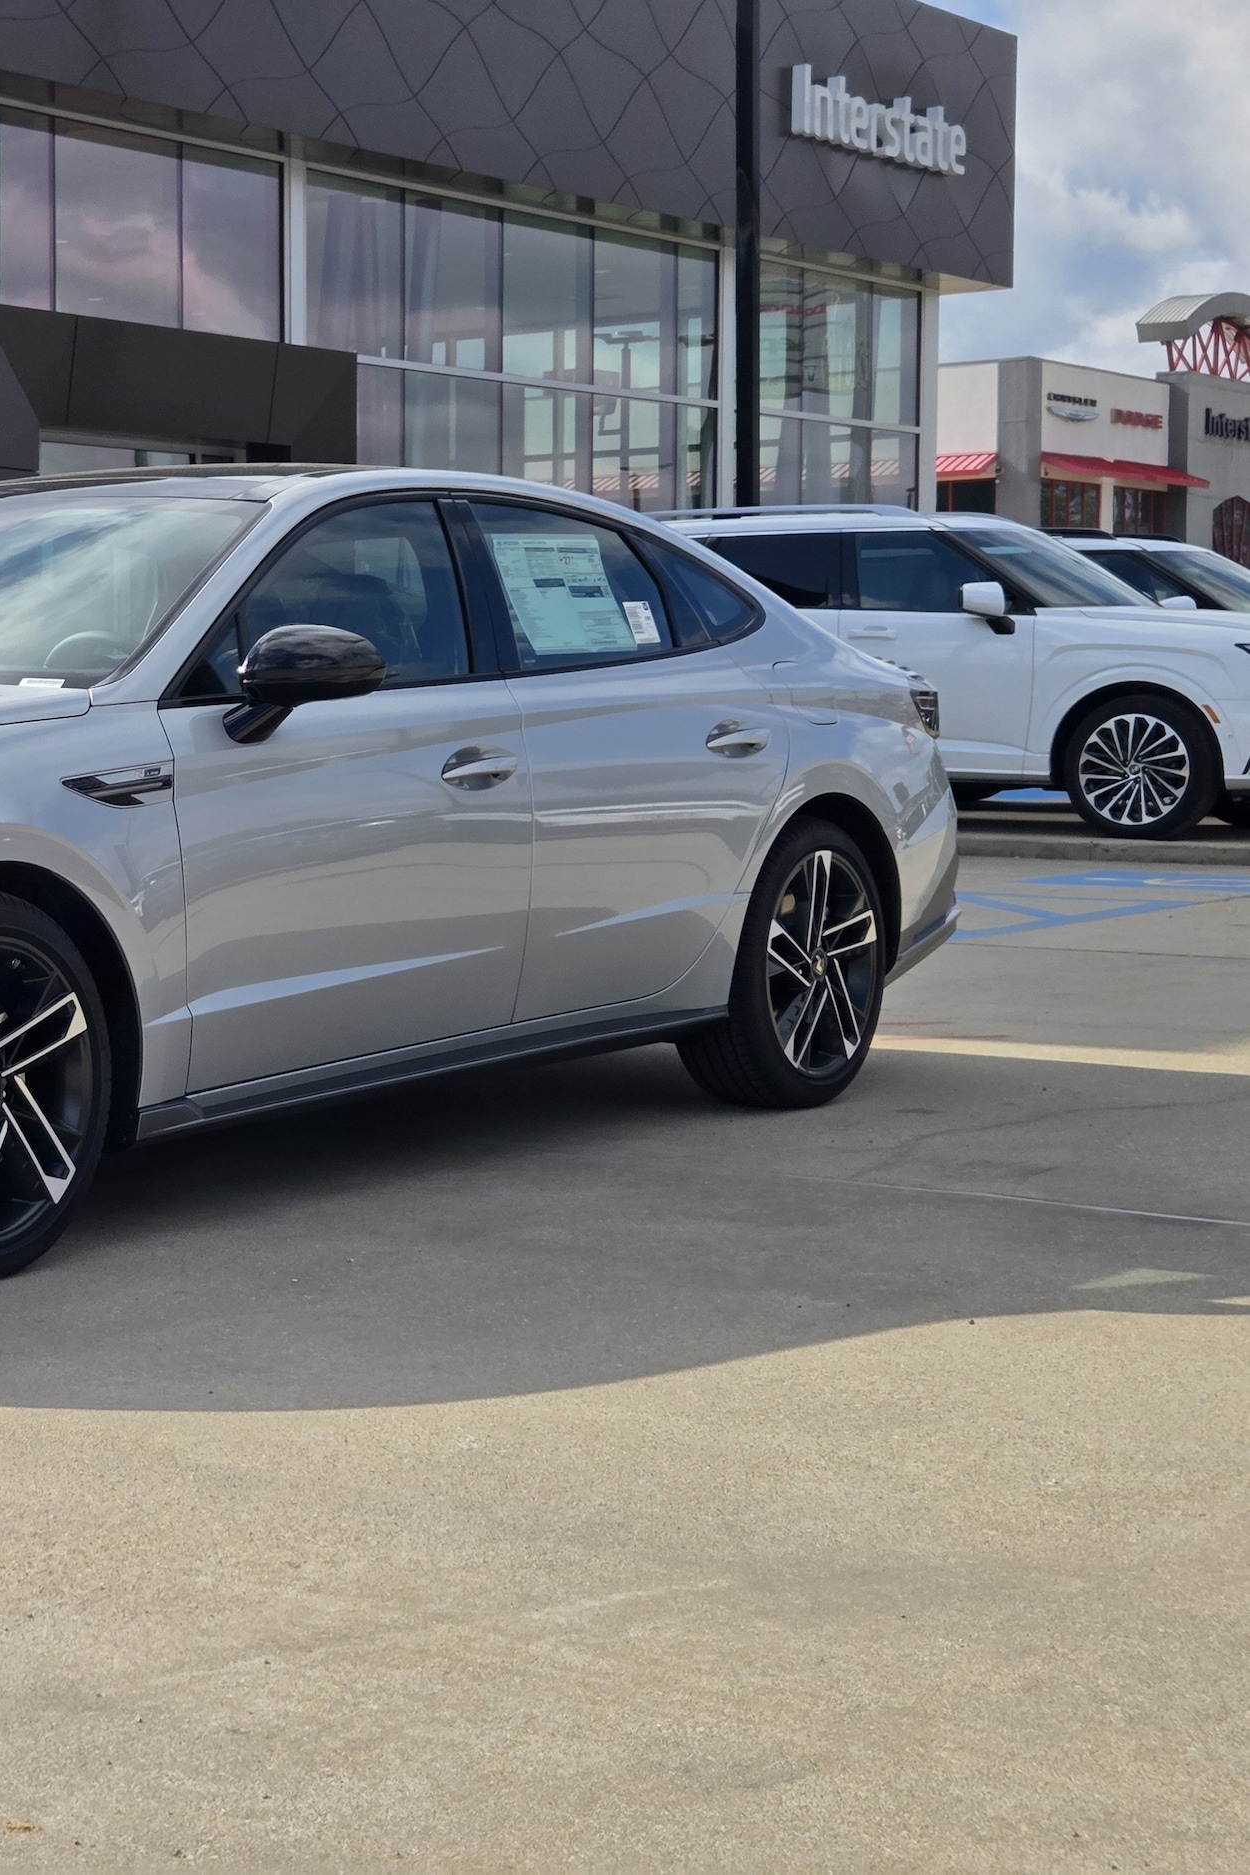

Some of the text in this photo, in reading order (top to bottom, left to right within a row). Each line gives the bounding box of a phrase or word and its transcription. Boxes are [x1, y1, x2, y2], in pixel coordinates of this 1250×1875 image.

[791, 63, 967, 176] Interstate
[1110, 407, 1163, 430] DODGE
[1204, 407, 1250, 441] Inters
